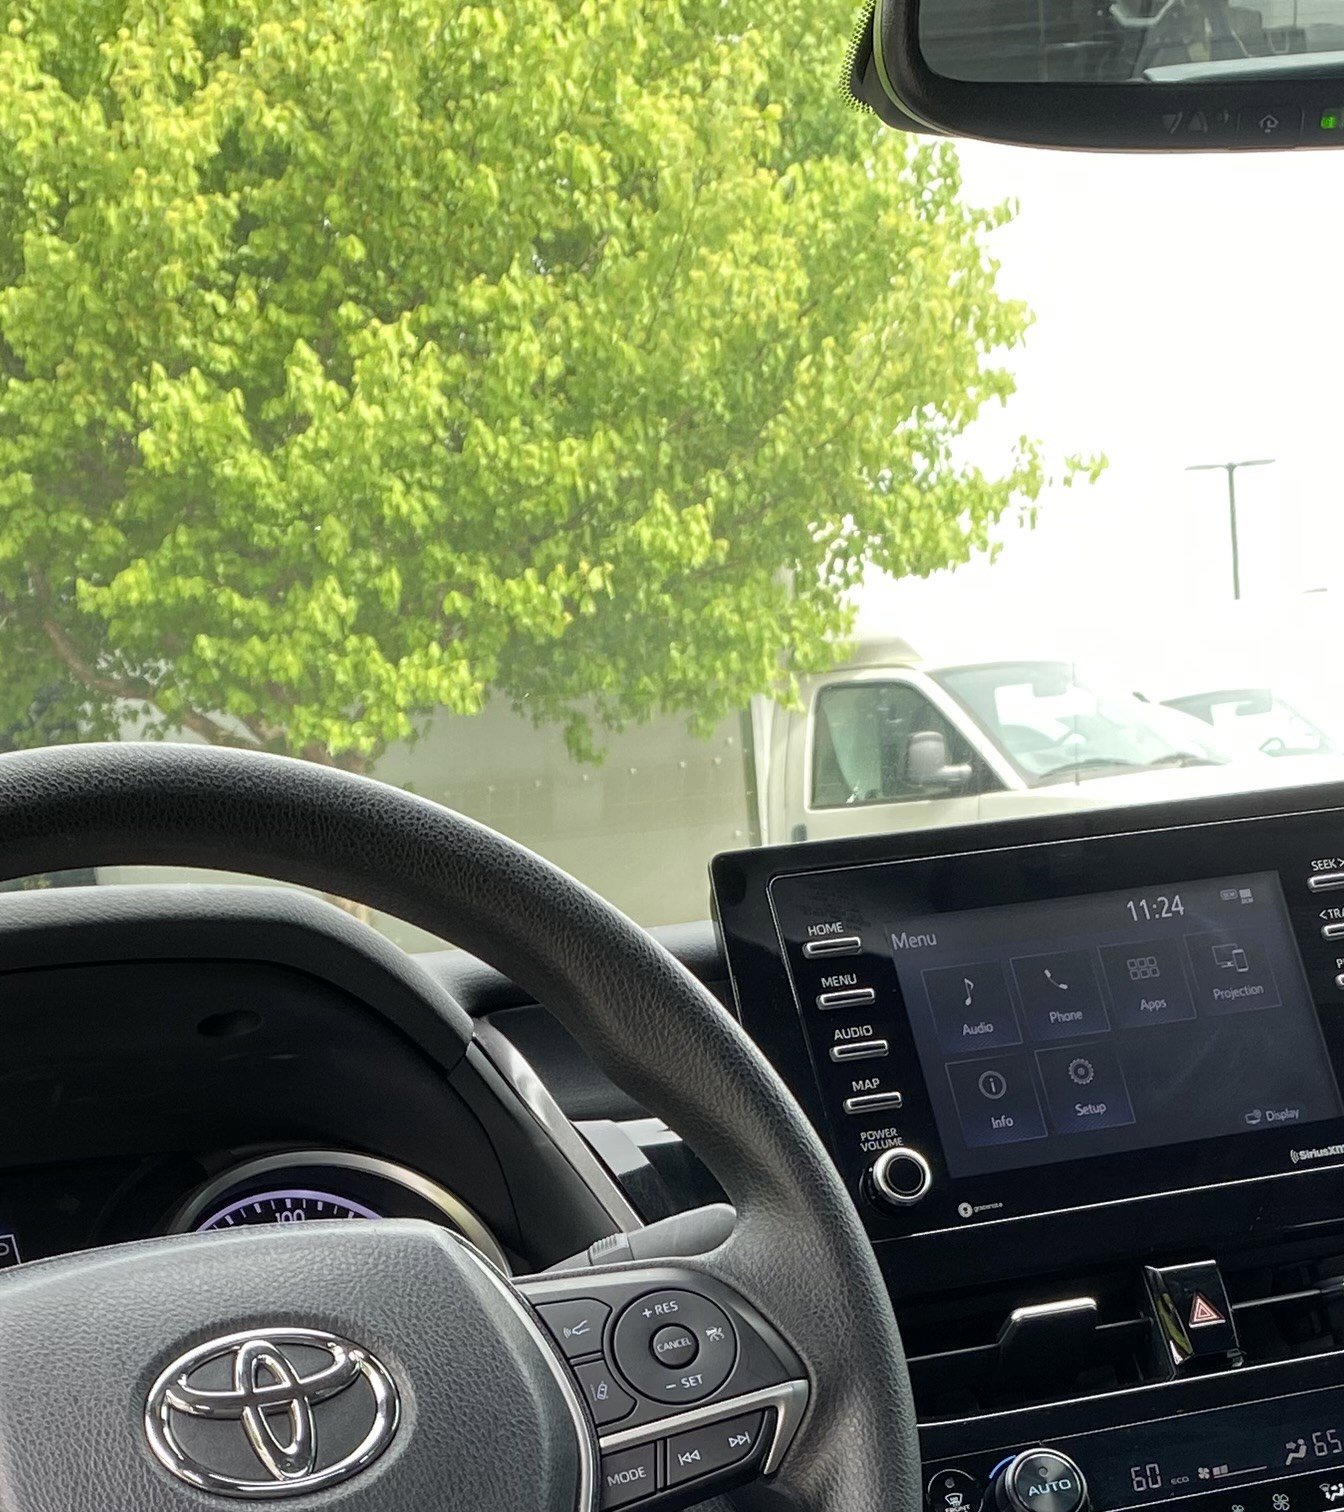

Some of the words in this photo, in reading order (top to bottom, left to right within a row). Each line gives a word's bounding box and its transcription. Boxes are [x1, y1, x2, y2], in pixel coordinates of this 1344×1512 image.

[1126, 894, 1185, 921] 11:24
[808, 922, 844, 936] HOME
[891, 932, 937, 950] Menu
[821, 974, 857, 988] MENU
[1213, 985, 1264, 1000] Projection
[1140, 999, 1167, 1012] Apps
[1049, 1010, 1083, 1024] Phone
[834, 1025, 873, 1040] AUDIO
[962, 1022, 994, 1036] Audio
[852, 1078, 880, 1092] MAP
[1074, 1103, 1106, 1117] Setup
[1265, 1108, 1299, 1122] Display
[991, 1114, 1014, 1129] Info
[860, 1127, 898, 1141] POWER
[860, 1137, 904, 1152] VOLUME
[656, 1337, 692, 1353] CANCEL
[1312, 1429, 1343, 1457] 65
[607, 1466, 647, 1487] MODE
[1130, 1463, 1162, 1492] 60
[1028, 1478, 1072, 1497] AUTO
